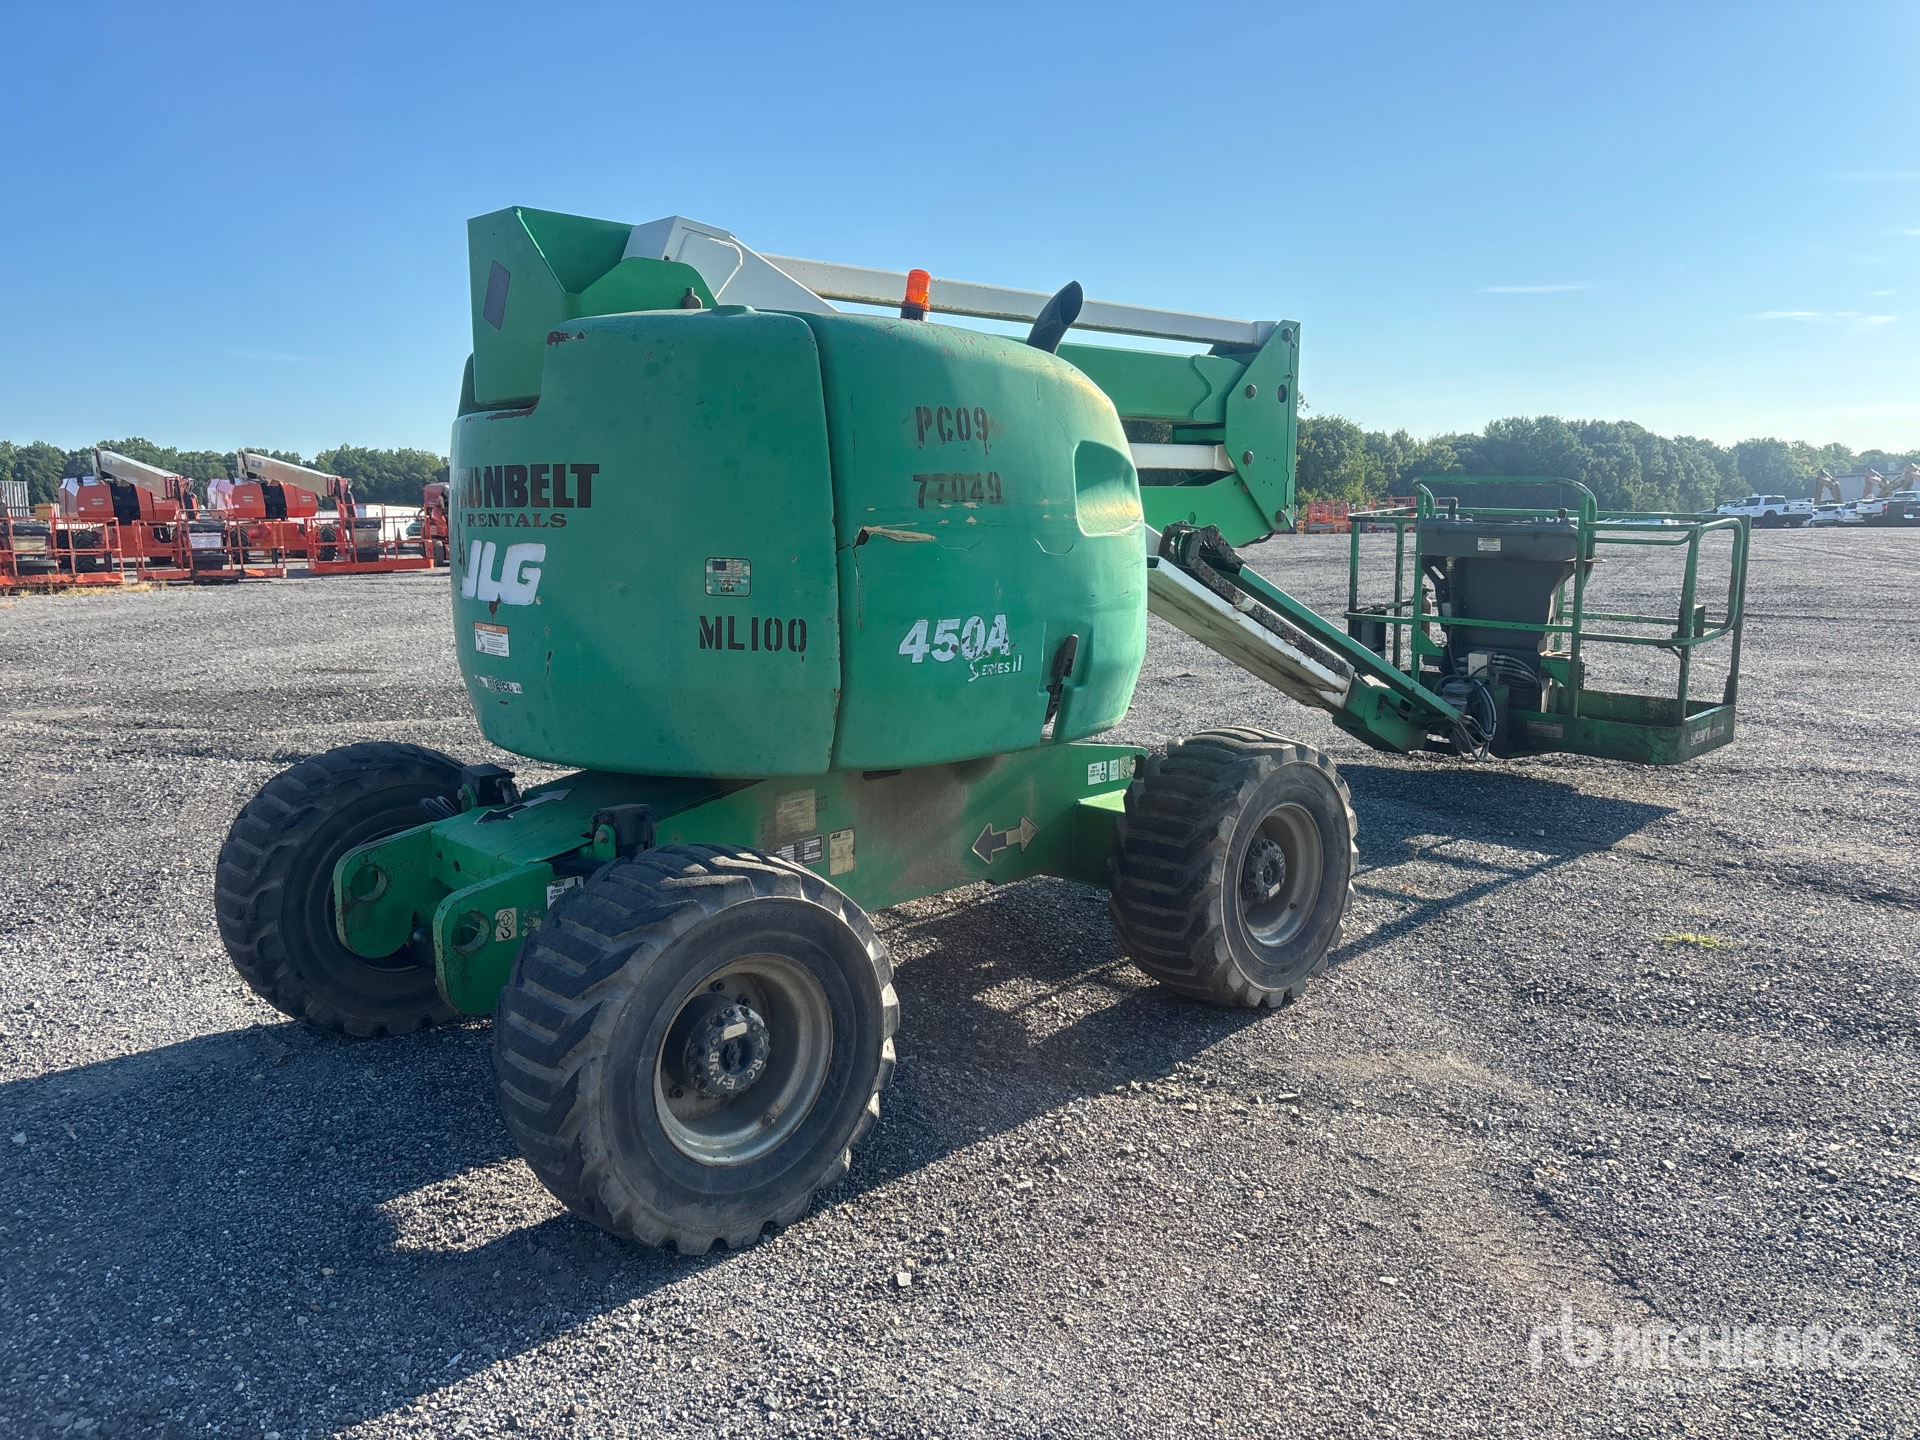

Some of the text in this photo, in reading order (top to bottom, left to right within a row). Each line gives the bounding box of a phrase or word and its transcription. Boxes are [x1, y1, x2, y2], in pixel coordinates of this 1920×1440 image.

[915, 406, 988, 442] PC09
[912, 472, 1002, 509] 77049
[467, 513, 567, 528] RENTALS
[461, 539, 547, 606] JLG
[699, 615, 807, 653] ML100
[899, 614, 1010, 664] 450A
